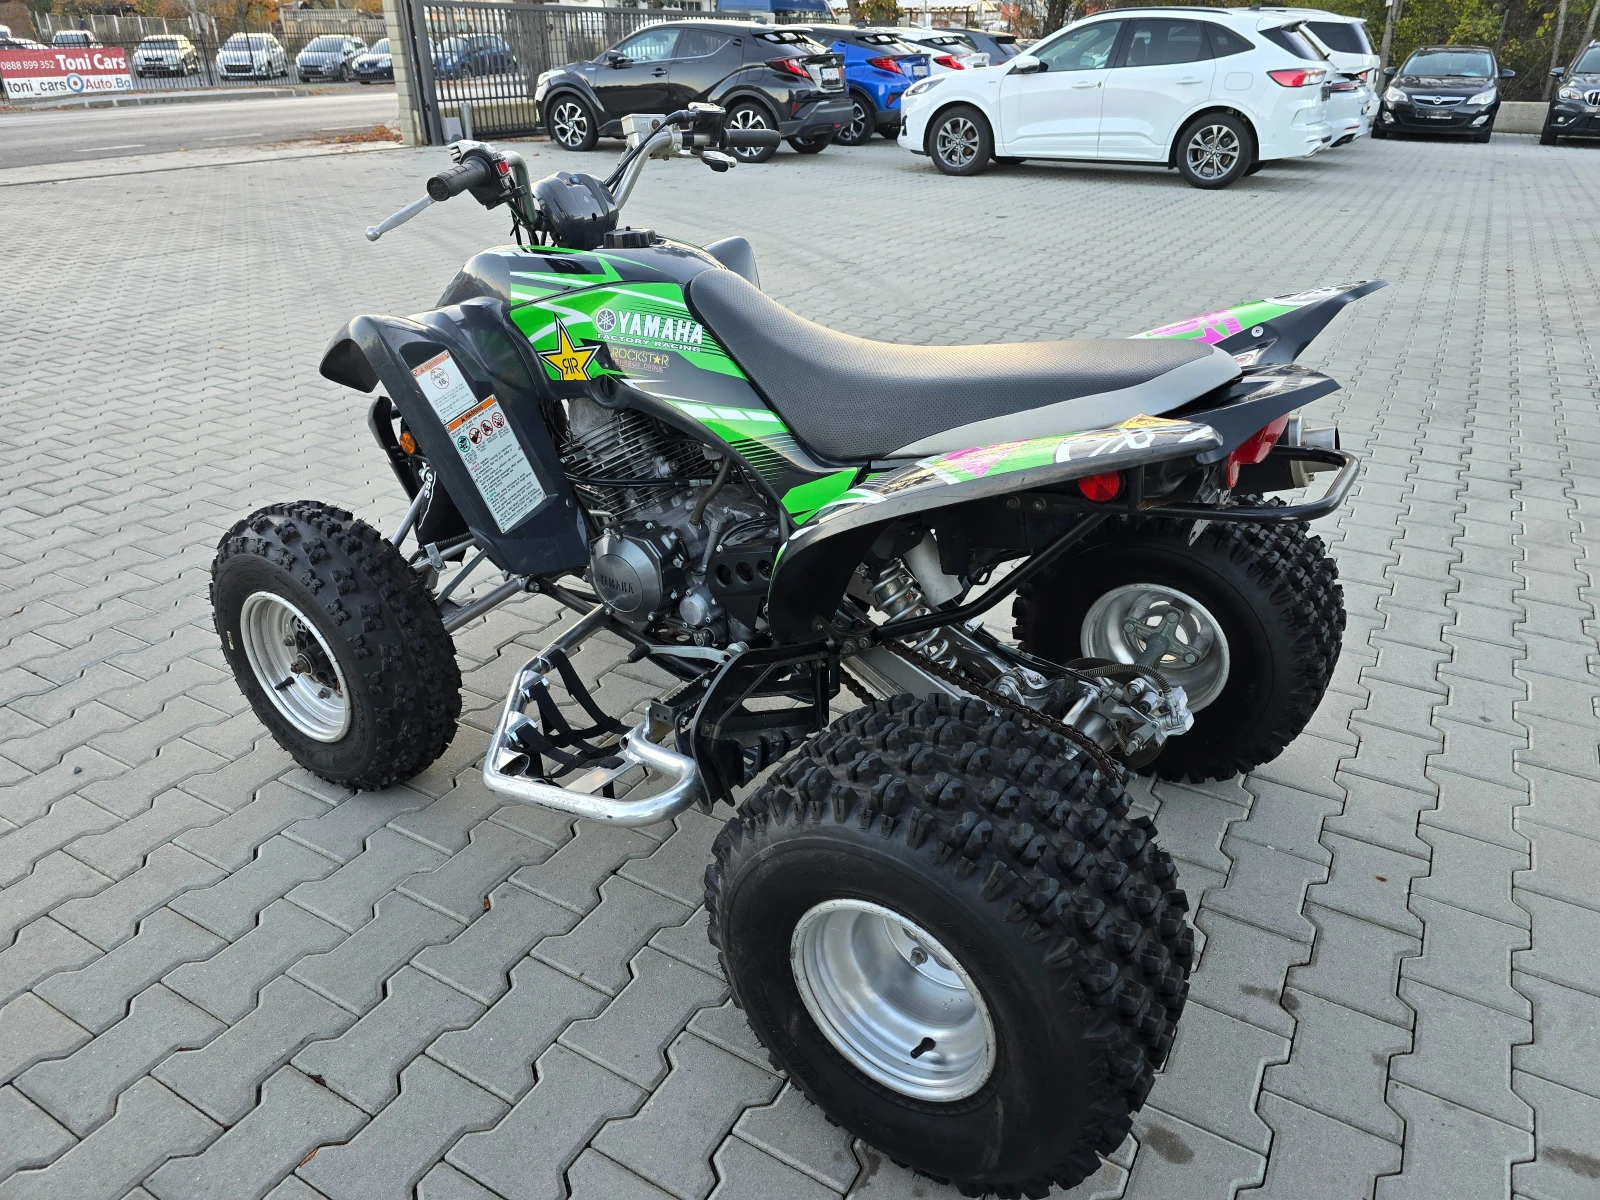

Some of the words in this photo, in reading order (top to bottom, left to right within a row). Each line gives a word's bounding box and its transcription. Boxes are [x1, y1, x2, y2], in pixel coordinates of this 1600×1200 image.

[1, 60, 21, 70] 0888
[23, 60, 38, 70] 899
[40, 60, 55, 69] 352
[55, 53, 92, 71] Toni
[93, 53, 126, 70] Cars
[618, 311, 703, 345] YAMAHA
[597, 333, 650, 345] FACTORY
[654, 341, 702, 352] RACING
[615, 359, 641, 368] ENERGY
[643, 363, 663, 372] DRINK
